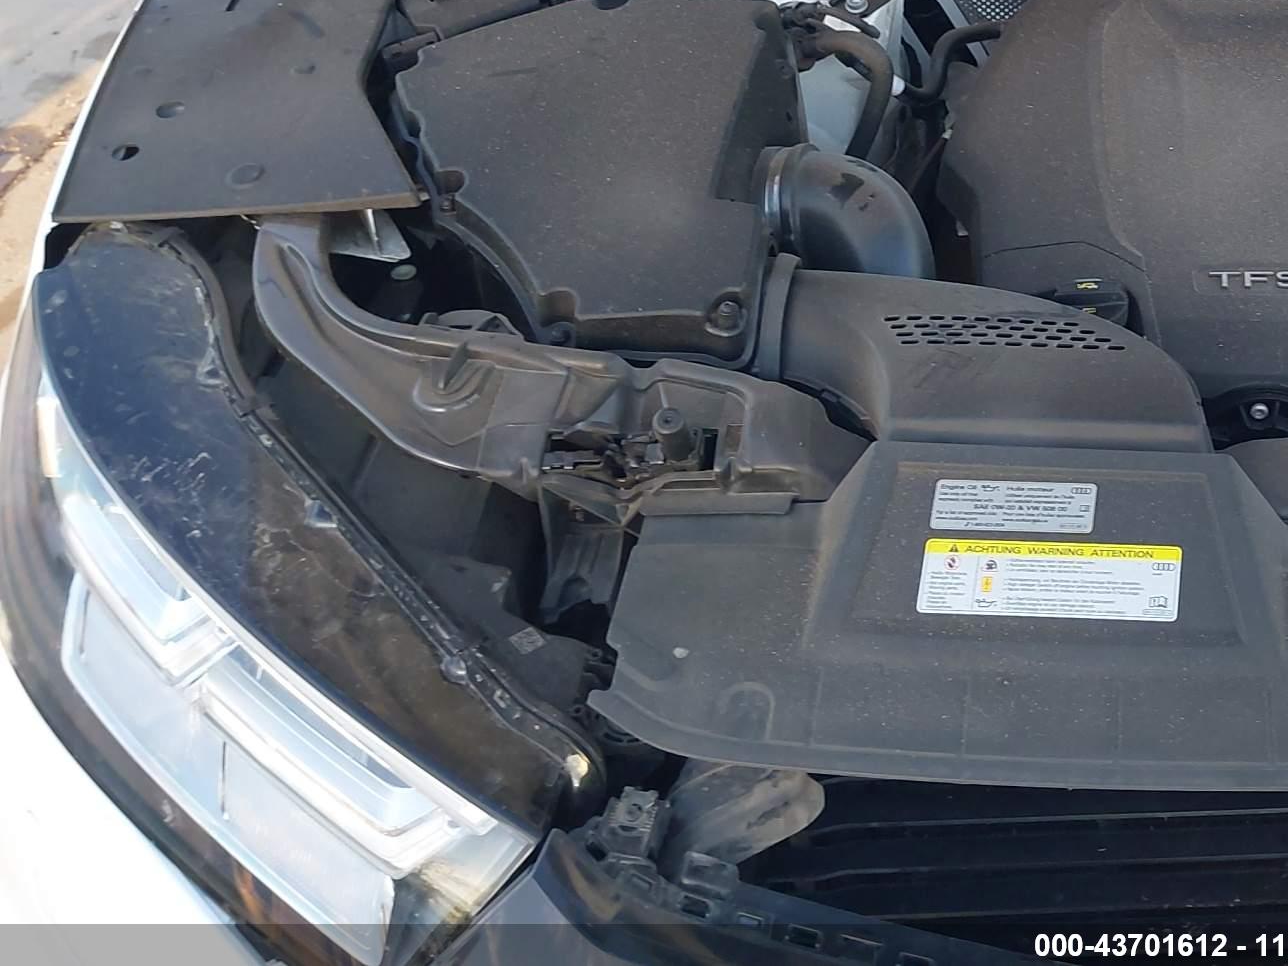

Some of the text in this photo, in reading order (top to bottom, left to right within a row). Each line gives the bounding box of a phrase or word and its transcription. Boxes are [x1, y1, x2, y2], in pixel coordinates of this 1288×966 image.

[964, 545, 1155, 558] ACHTUNG WARNING ATTENTION
